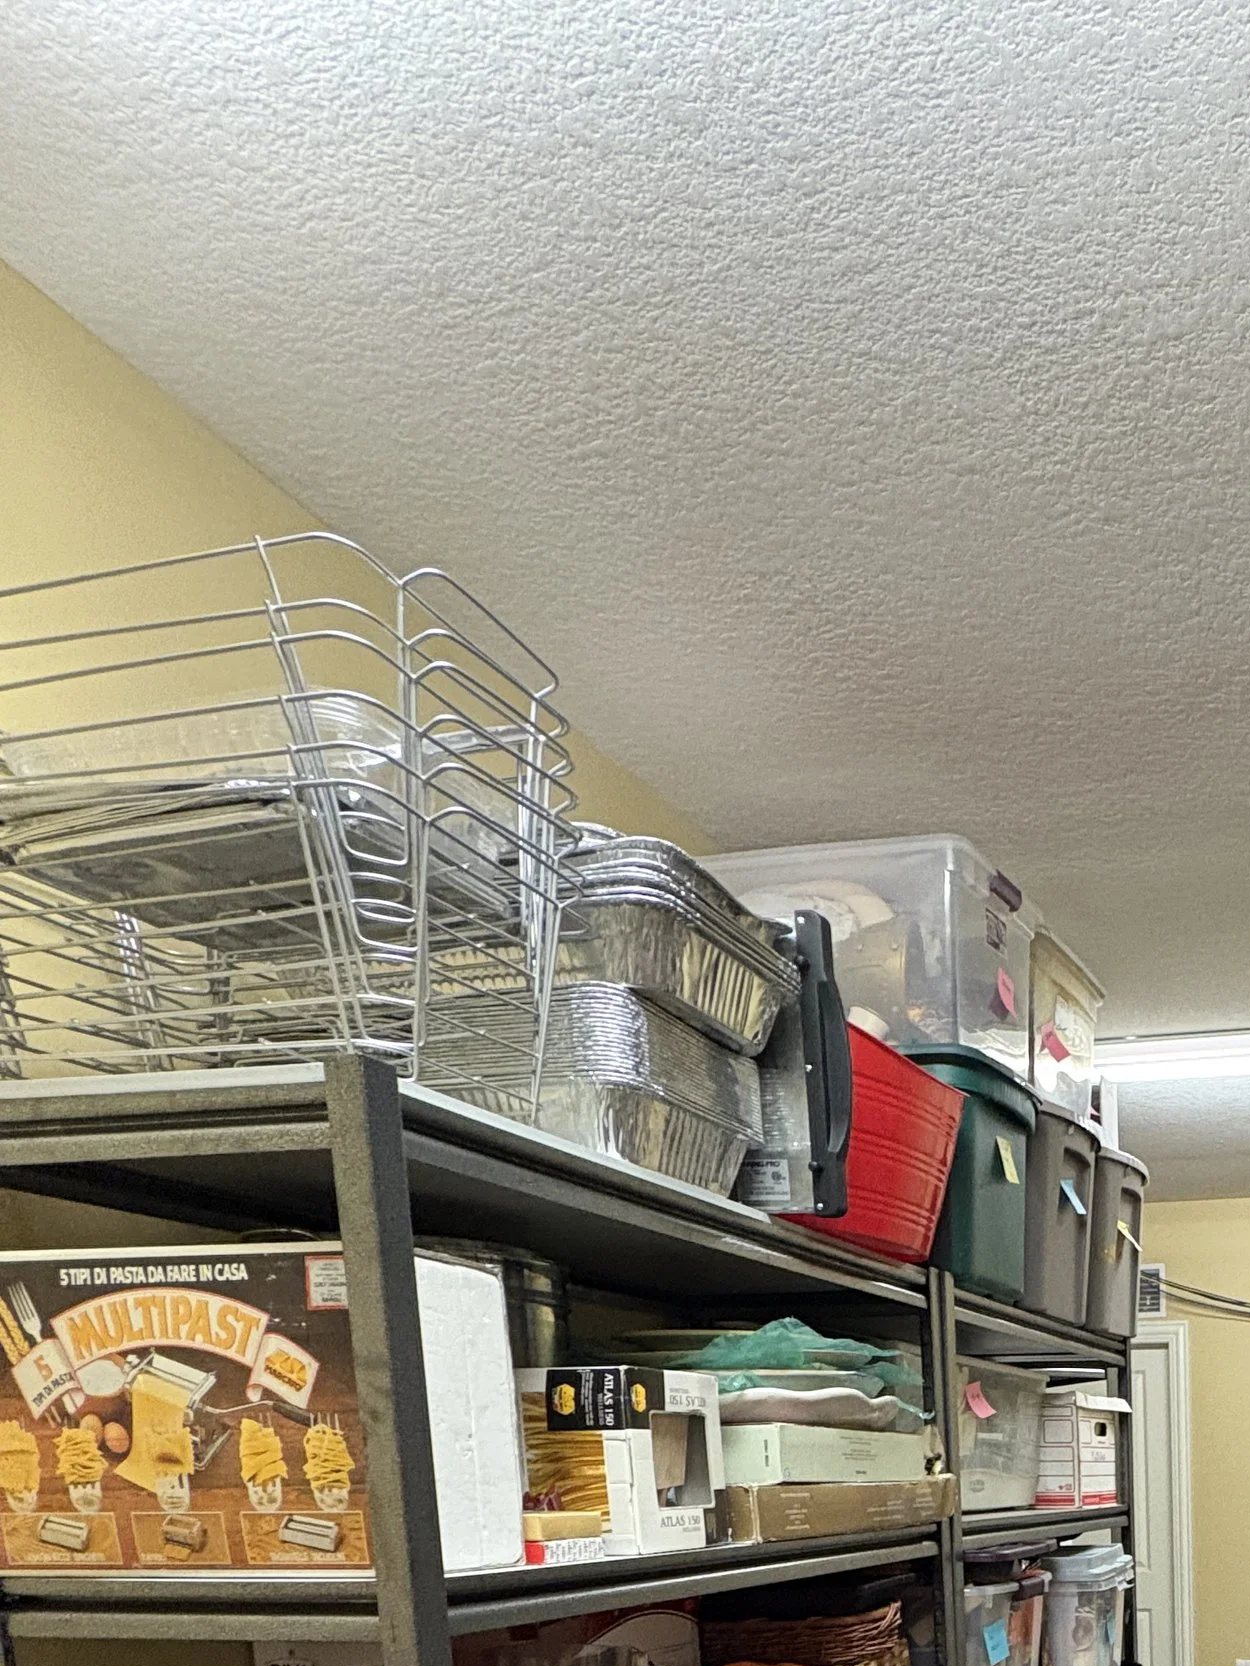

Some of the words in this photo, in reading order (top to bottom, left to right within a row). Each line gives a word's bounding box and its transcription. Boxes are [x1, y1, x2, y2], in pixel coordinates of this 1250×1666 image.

[93, 1267, 107, 1284] DI
[109, 1266, 145, 1284] PASTA
[149, 1265, 166, 1283] DA
[166, 1264, 197, 1282] FARE
[199, 1264, 212, 1282] IN
[214, 1263, 249, 1281] CASA
[68, 1294, 261, 1361] MULTIPAST
[51, 1371, 76, 1389] PASTA
[603, 1373, 614, 1406] ATLAS
[604, 1409, 615, 1426] 150
[660, 1514, 686, 1528] ATLAS
